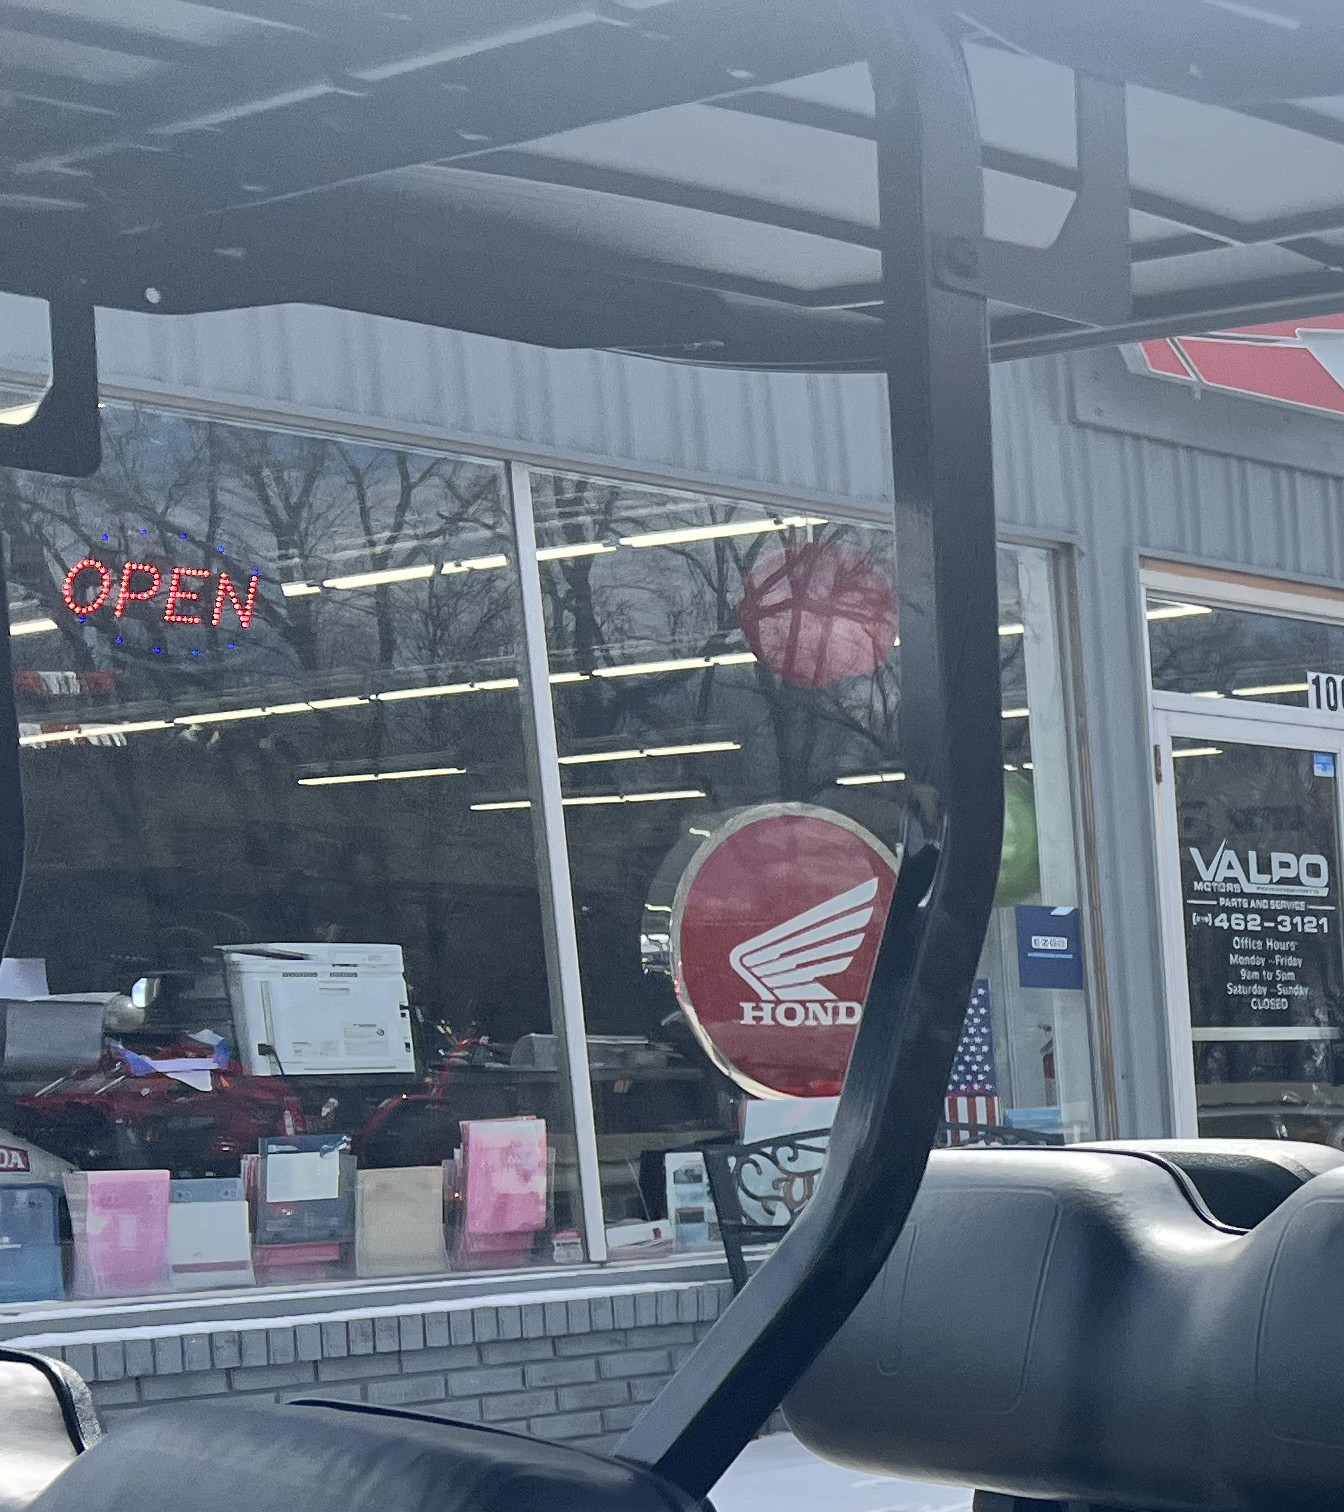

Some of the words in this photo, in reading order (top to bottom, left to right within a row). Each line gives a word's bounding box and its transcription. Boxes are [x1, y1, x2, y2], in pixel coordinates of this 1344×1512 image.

[63, 558, 259, 628] OPEN
[1189, 838, 1329, 892] VALPO
[1193, 881, 1241, 893] MOTORS
[1219, 897, 1249, 909] PARTS
[1250, 899, 1269, 910] AND
[1229, 953, 1266, 967] Monday
[1226, 982, 1269, 996] Saturday
[1250, 998, 1289, 1010] CLOSED
[739, 1001, 863, 1027] HOND
